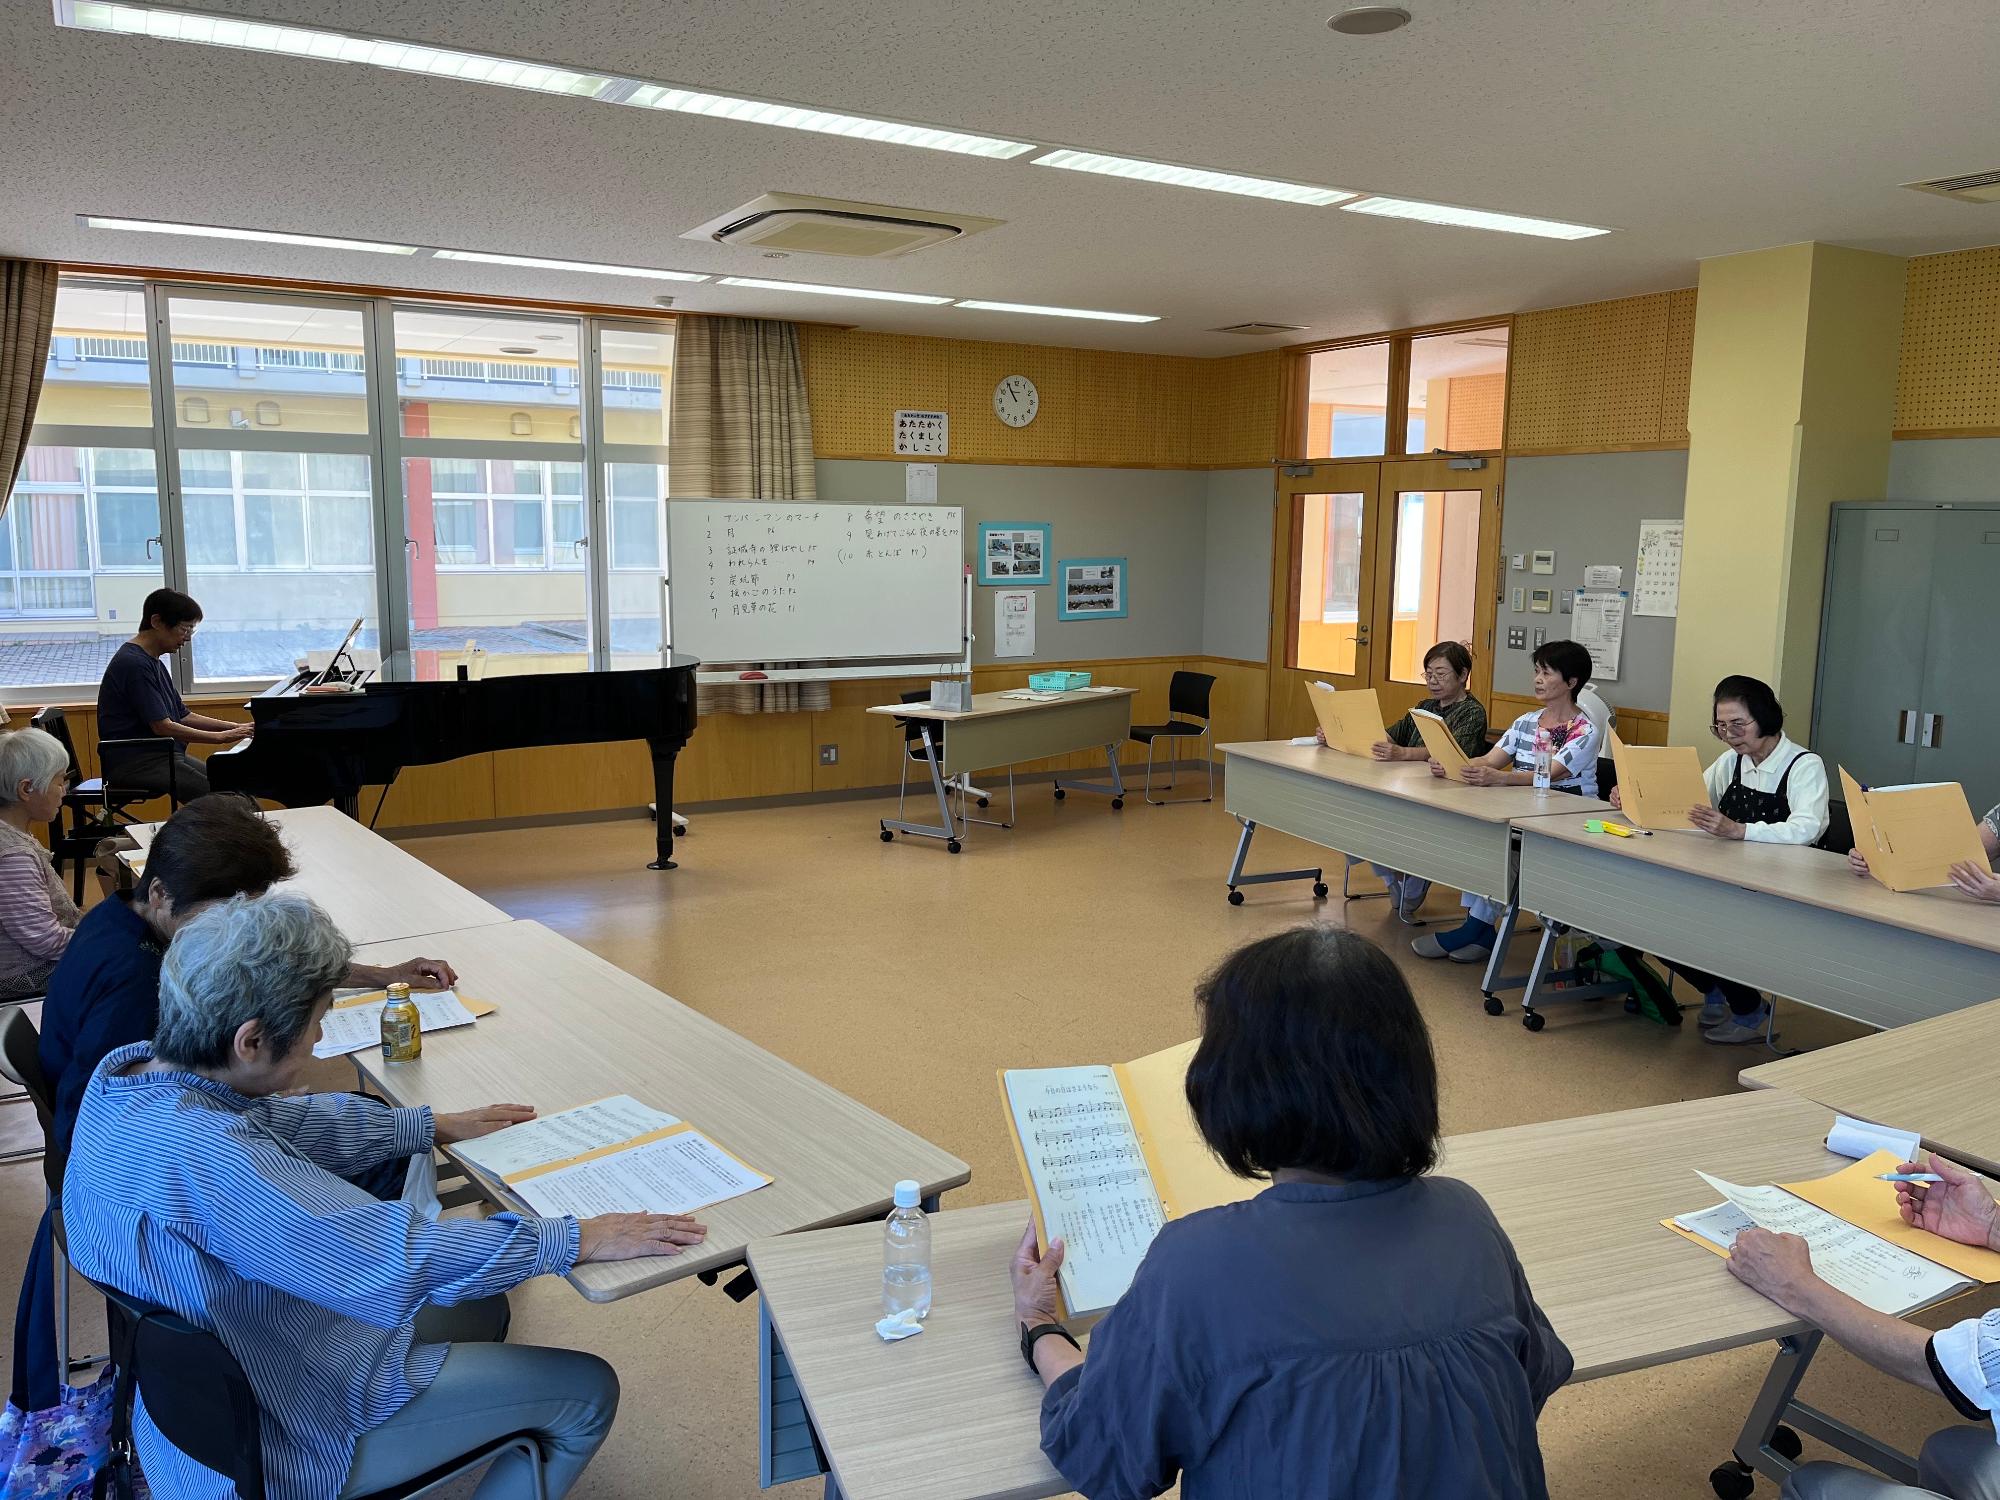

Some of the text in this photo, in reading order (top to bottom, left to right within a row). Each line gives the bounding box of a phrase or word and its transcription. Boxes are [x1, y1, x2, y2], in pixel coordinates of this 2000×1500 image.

[899, 419, 942, 430] あたたかく
[899, 431, 942, 441] たくましく
[899, 443, 942, 453] かしこく
